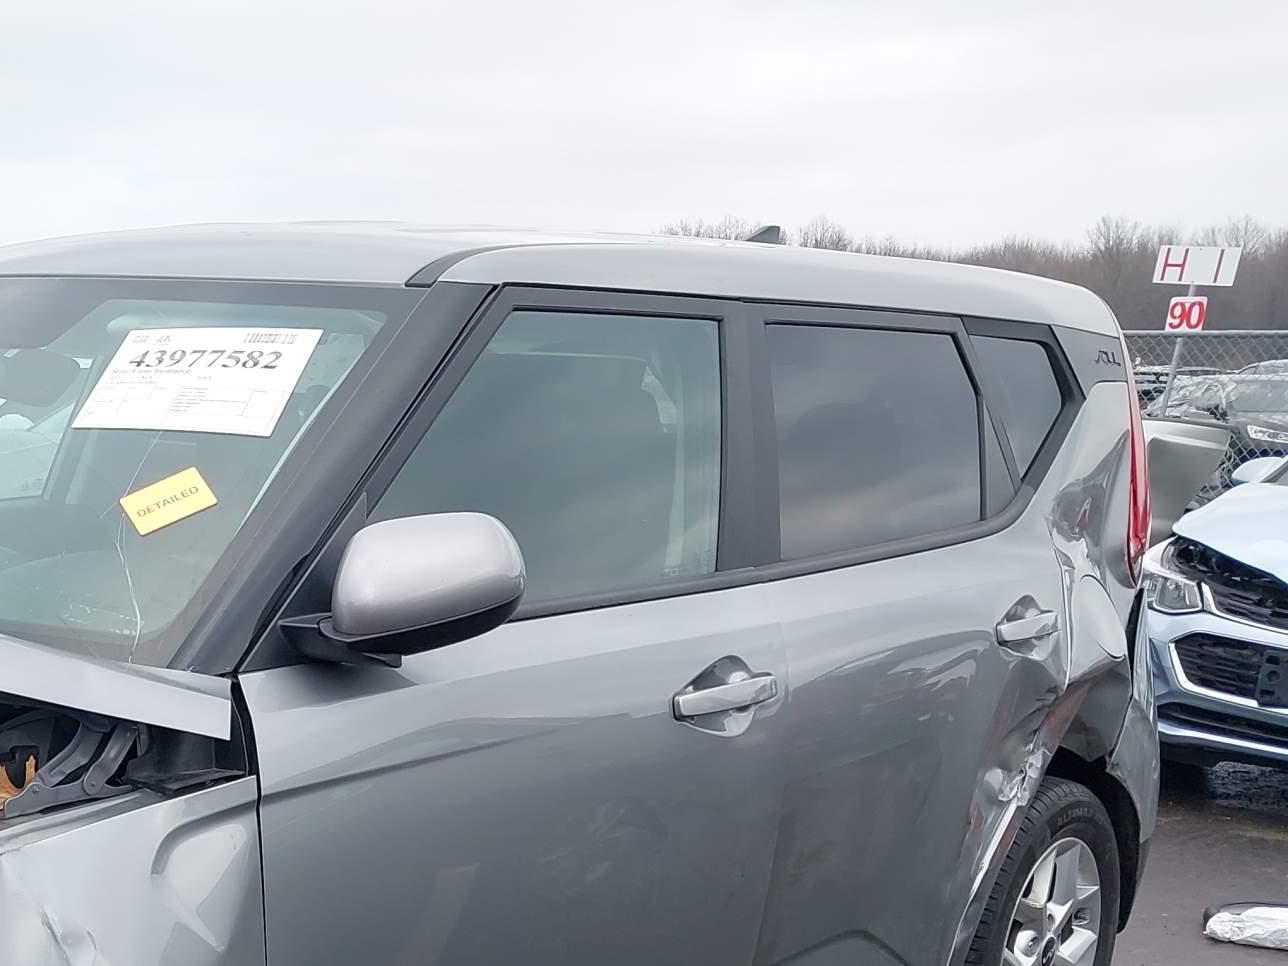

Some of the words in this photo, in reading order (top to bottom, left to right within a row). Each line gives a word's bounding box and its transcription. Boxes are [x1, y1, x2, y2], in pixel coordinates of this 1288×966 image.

[1160, 247, 1190, 282] H
[1168, 301, 1205, 329] 90
[128, 350, 283, 369] 43977582
[137, 486, 199, 517] DETAILED
